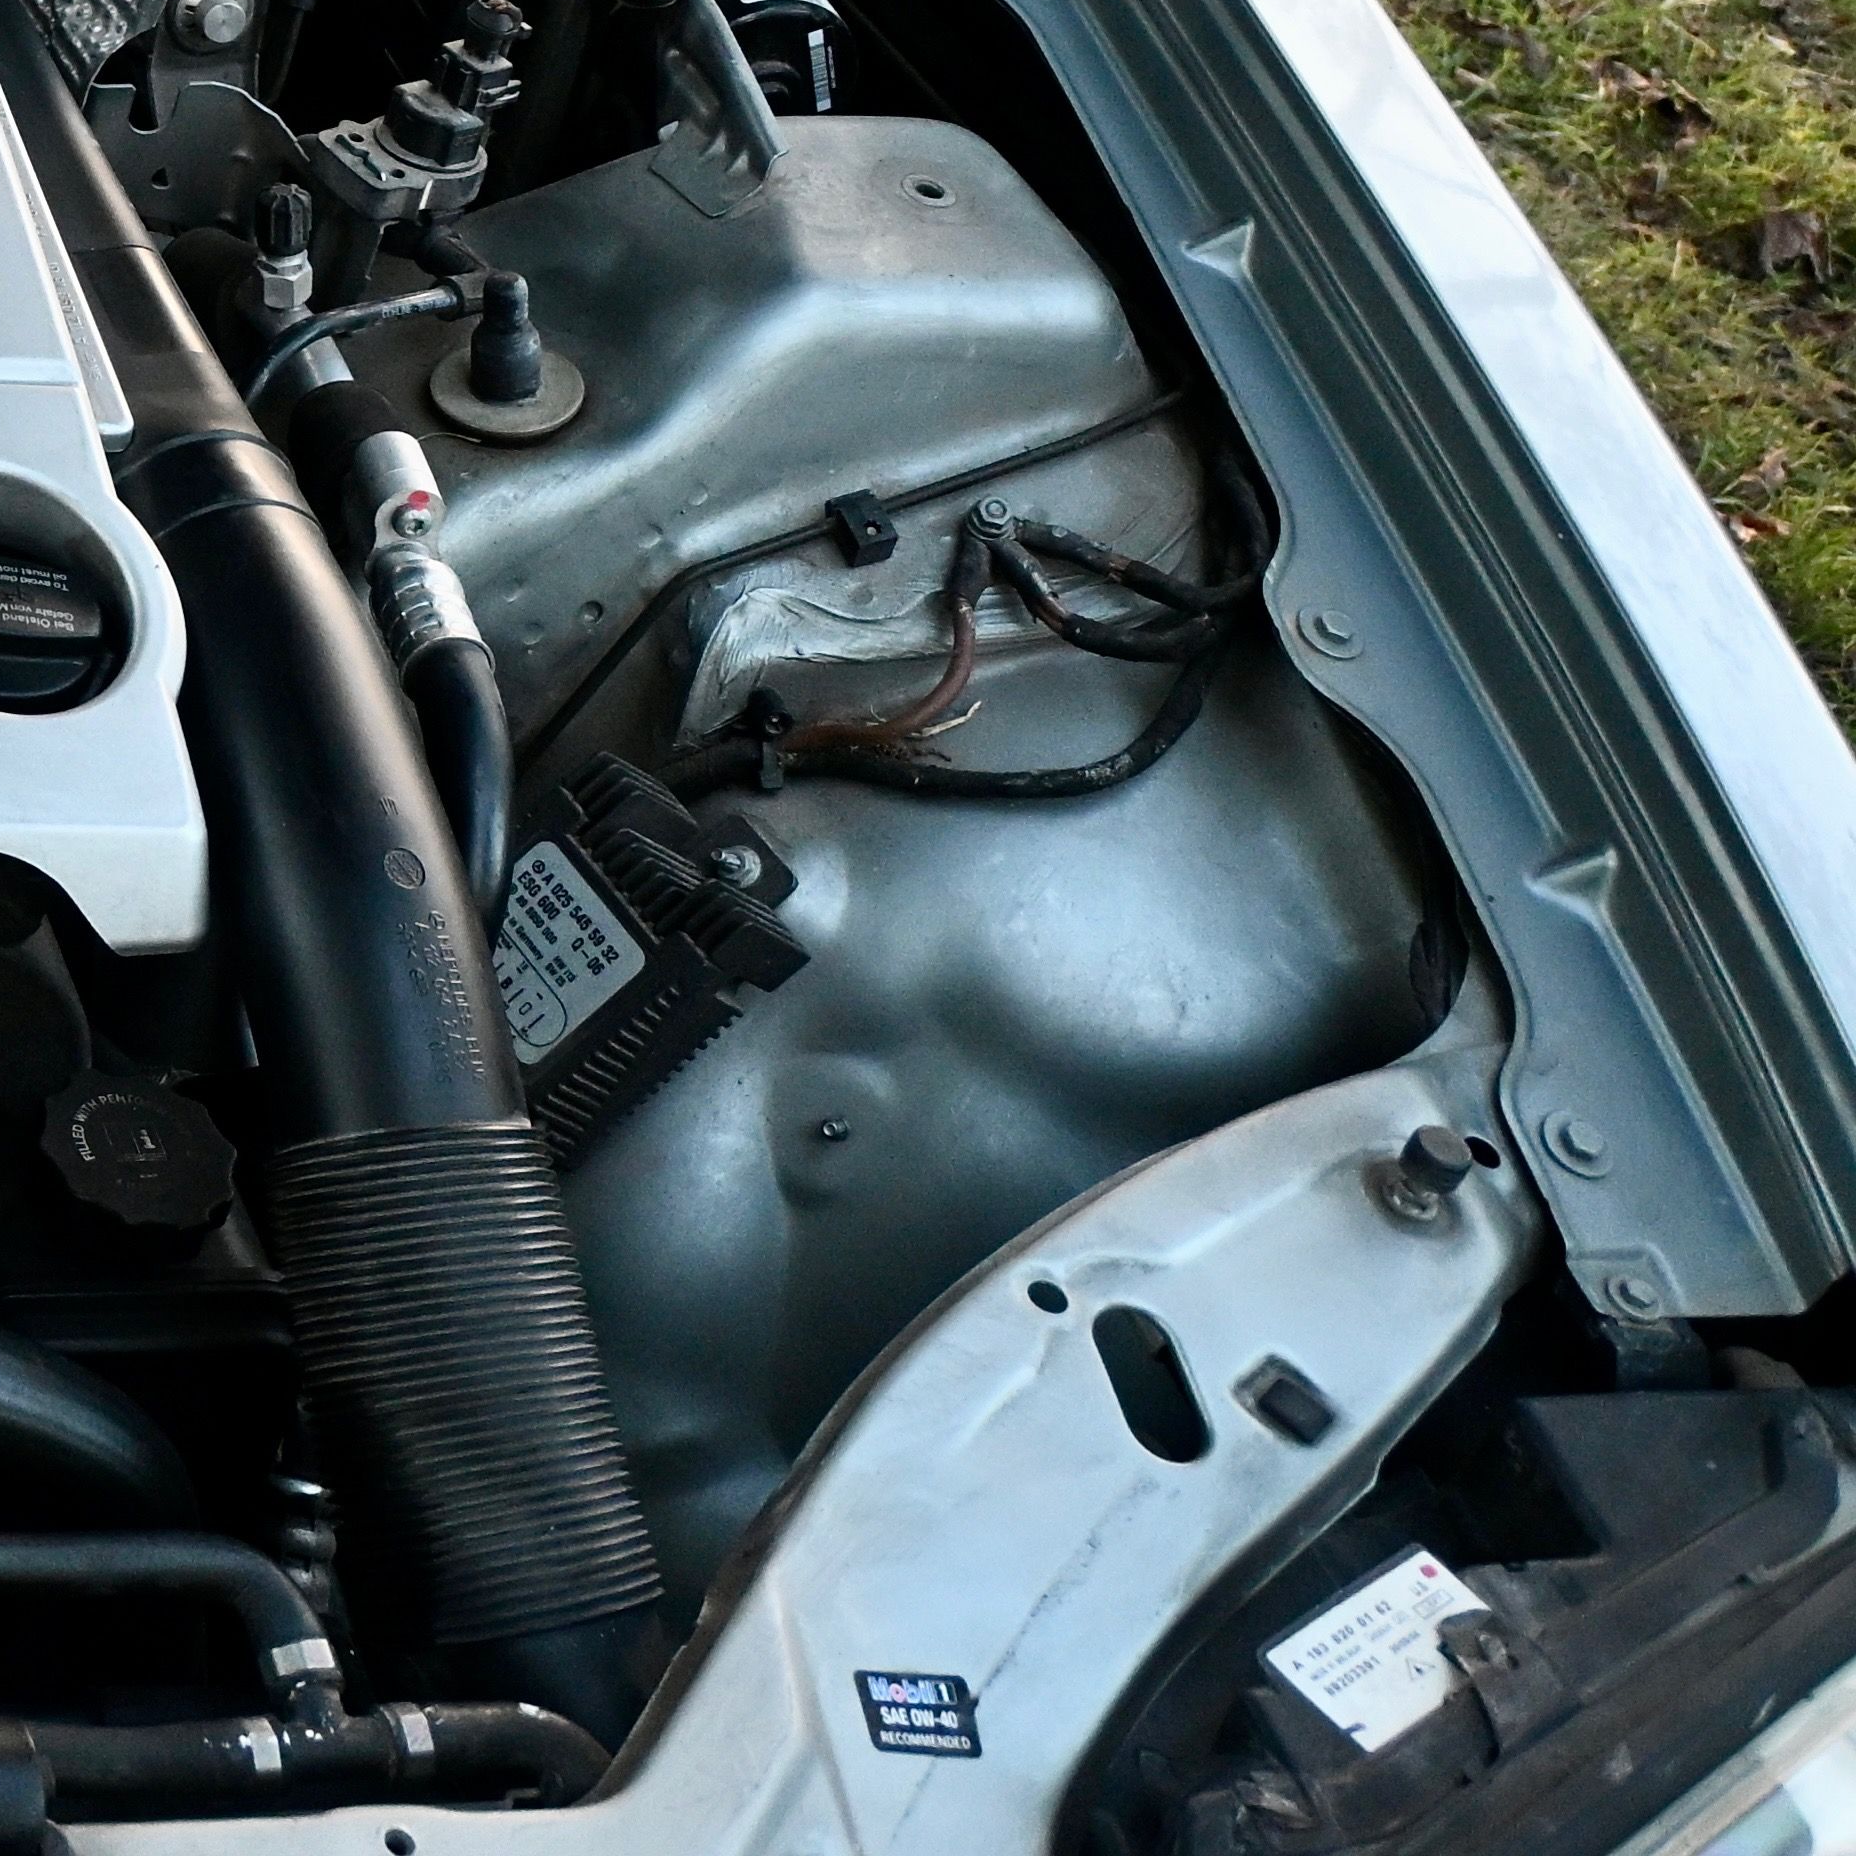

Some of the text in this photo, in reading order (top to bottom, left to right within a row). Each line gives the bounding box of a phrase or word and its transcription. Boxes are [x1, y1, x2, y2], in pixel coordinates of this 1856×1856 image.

[18, 575, 52, 588] avoid
[19, 567, 51, 578] must
[52, 580, 70, 592] To
[9, 602, 33, 613] von
[34, 607, 75, 621] Gefahr
[53, 619, 75, 632] Bei
[516, 869, 543, 899] ESG
[535, 892, 563, 922] 600
[540, 870, 621, 966] A 025 545 59 32
[515, 926, 544, 961] Germany
[74, 1100, 100, 1122] WITH
[71, 1123, 96, 1162] FILLED
[865, 1675, 939, 1705] Mobil
[879, 1707, 912, 1727] SAE
[879, 1729, 972, 1752] RECOMMENDED
